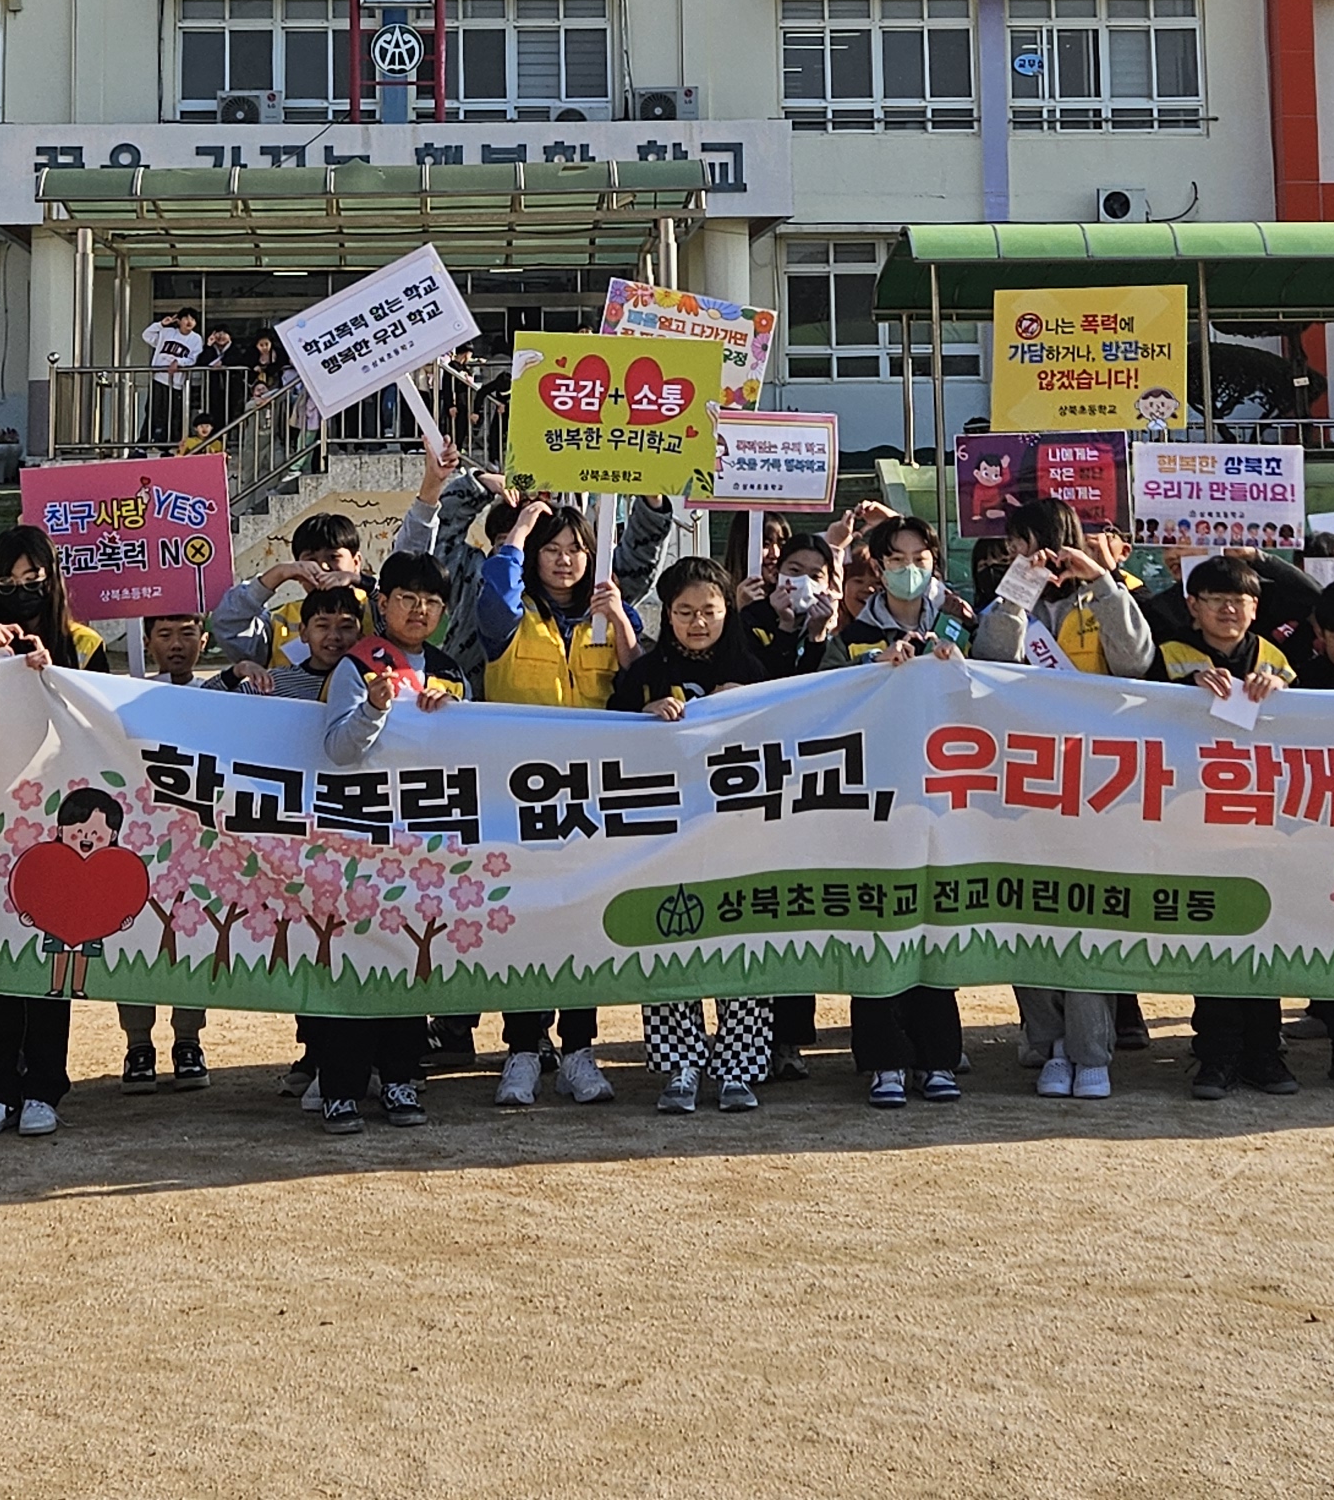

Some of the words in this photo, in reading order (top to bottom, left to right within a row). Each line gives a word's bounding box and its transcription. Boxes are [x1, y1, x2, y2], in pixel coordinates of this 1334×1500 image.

[301, 313, 370, 356] 학교폭력
[368, 297, 405, 322] 없는
[402, 275, 440, 302] 학교
[1045, 317, 1076, 334] 나는
[1080, 313, 1135, 334] 폭력에
[320, 338, 373, 375] 행복한
[372, 319, 408, 346] 우리
[405, 300, 444, 326] 학교
[690, 321, 748, 347] 다가가면
[1008, 342, 1096, 364] 가담하거나,
[1101, 340, 1172, 362] 방관하지
[1037, 368, 1139, 391] 않겠습니다!
[550, 379, 605, 411] 공감
[630, 383, 685, 416] 소통
[1058, 404, 1117, 417] 상북초등학교
[544, 427, 603, 452] 행복한
[607, 427, 683, 454] 우리학교
[781, 441, 802, 455] 우리
[804, 442, 827, 455] 학교
[736, 456, 758, 471] 웃음
[760, 457, 782, 472] 가득
[783, 458, 827, 473] 행복학교
[1048, 446, 1099, 462] 나에게는
[1156, 454, 1218, 475] 행복한
[1224, 456, 1283, 476] 상북초
[579, 468, 642, 482] 상북초등학교
[1049, 468, 1075, 482] 작은
[1143, 480, 1203, 500] 우리가
[1208, 481, 1296, 503] 만들어요!
[44, 497, 148, 534] 친구사랑
[152, 485, 207, 528] YES
[99, 586, 163, 602] 상북초등학교
[140, 742, 481, 846] 학교폭력
[508, 759, 682, 842] 없는
[706, 731, 896, 823] 학교,
[923, 724, 1176, 822] 우리가
[715, 882, 919, 924] 상북초등학교
[932, 877, 1132, 921] 전교어린이회
[1152, 887, 1217, 923] 일동
